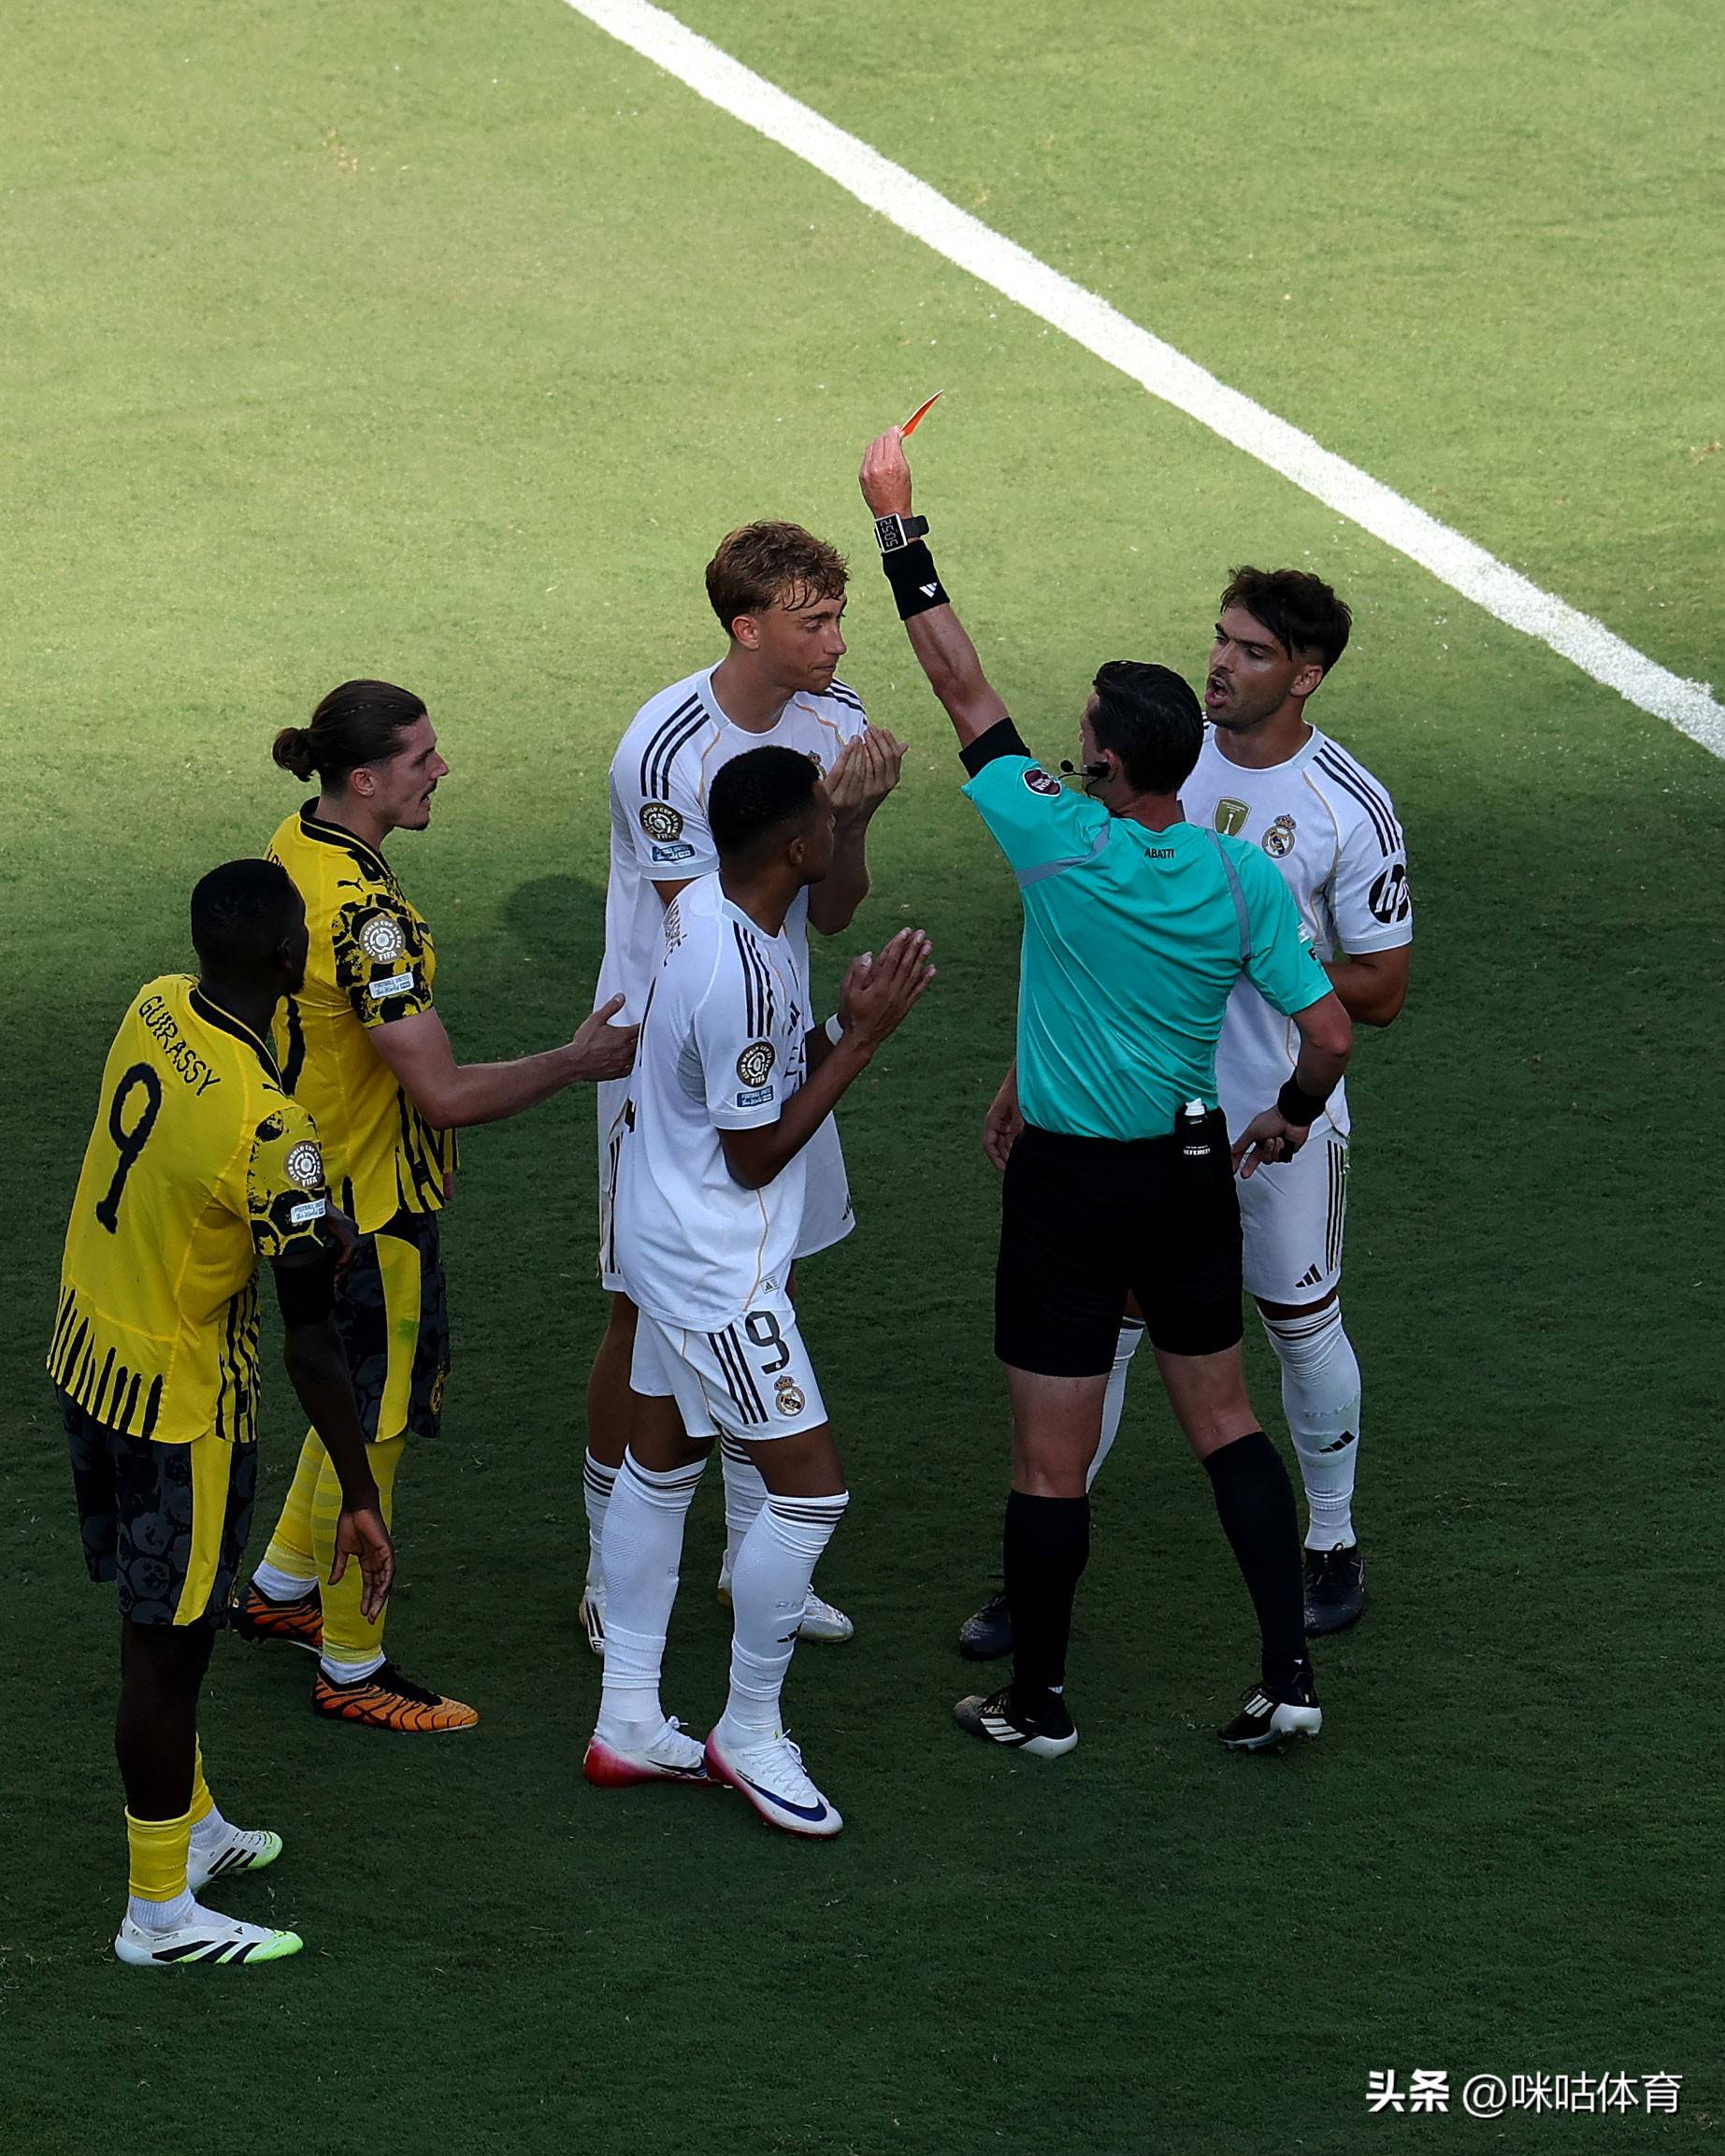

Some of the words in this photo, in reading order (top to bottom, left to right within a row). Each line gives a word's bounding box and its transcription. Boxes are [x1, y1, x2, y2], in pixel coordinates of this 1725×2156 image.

[1143, 847, 1175, 859] ABATTI
[1373, 866, 1409, 924] hp
[378, 950, 397, 962] FIFA
[138, 995, 222, 1098] GUIRASSY
[96, 1062, 162, 1235] 9
[301, 1175, 318, 1187] FIFA
[745, 1311, 790, 1374] 9
